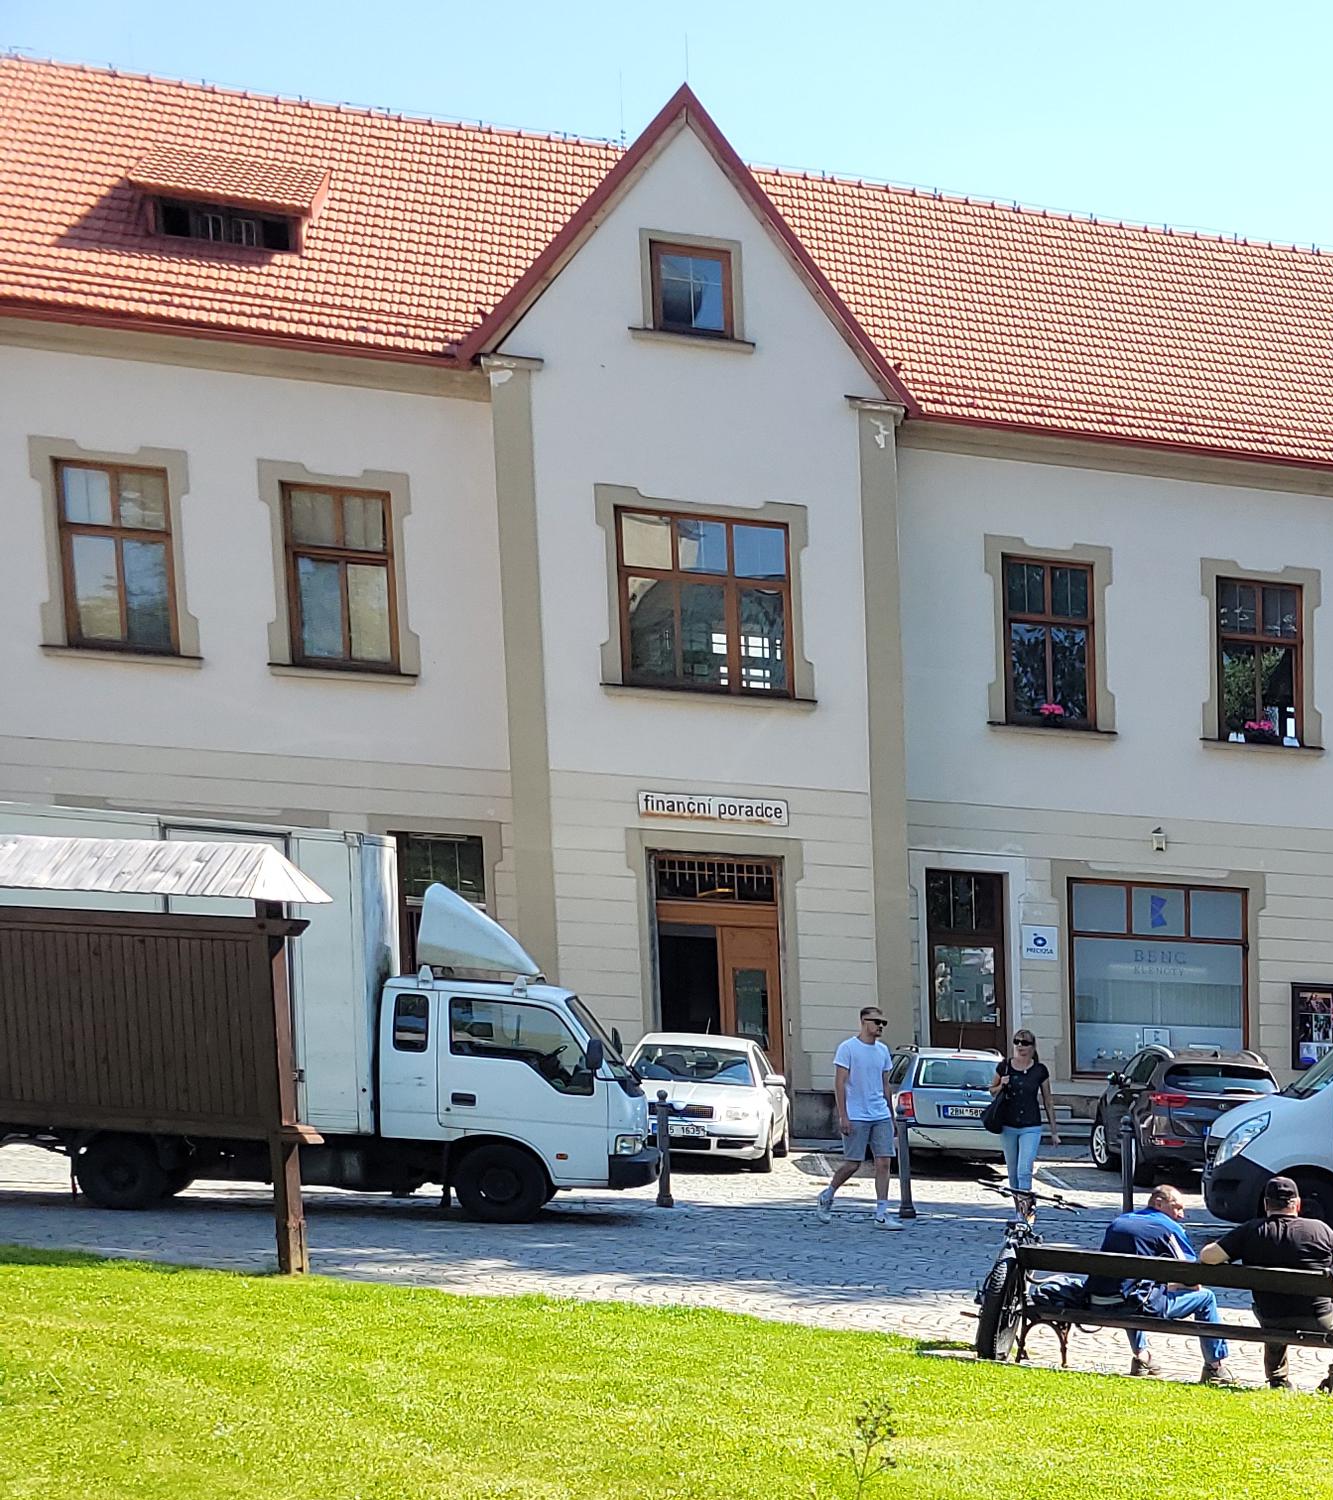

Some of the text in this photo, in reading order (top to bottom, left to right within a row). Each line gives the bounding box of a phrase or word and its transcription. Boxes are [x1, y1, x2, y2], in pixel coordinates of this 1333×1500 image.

[643, 793, 783, 819] finanční poradce
[1026, 947, 1053, 955] PRECIOSA
